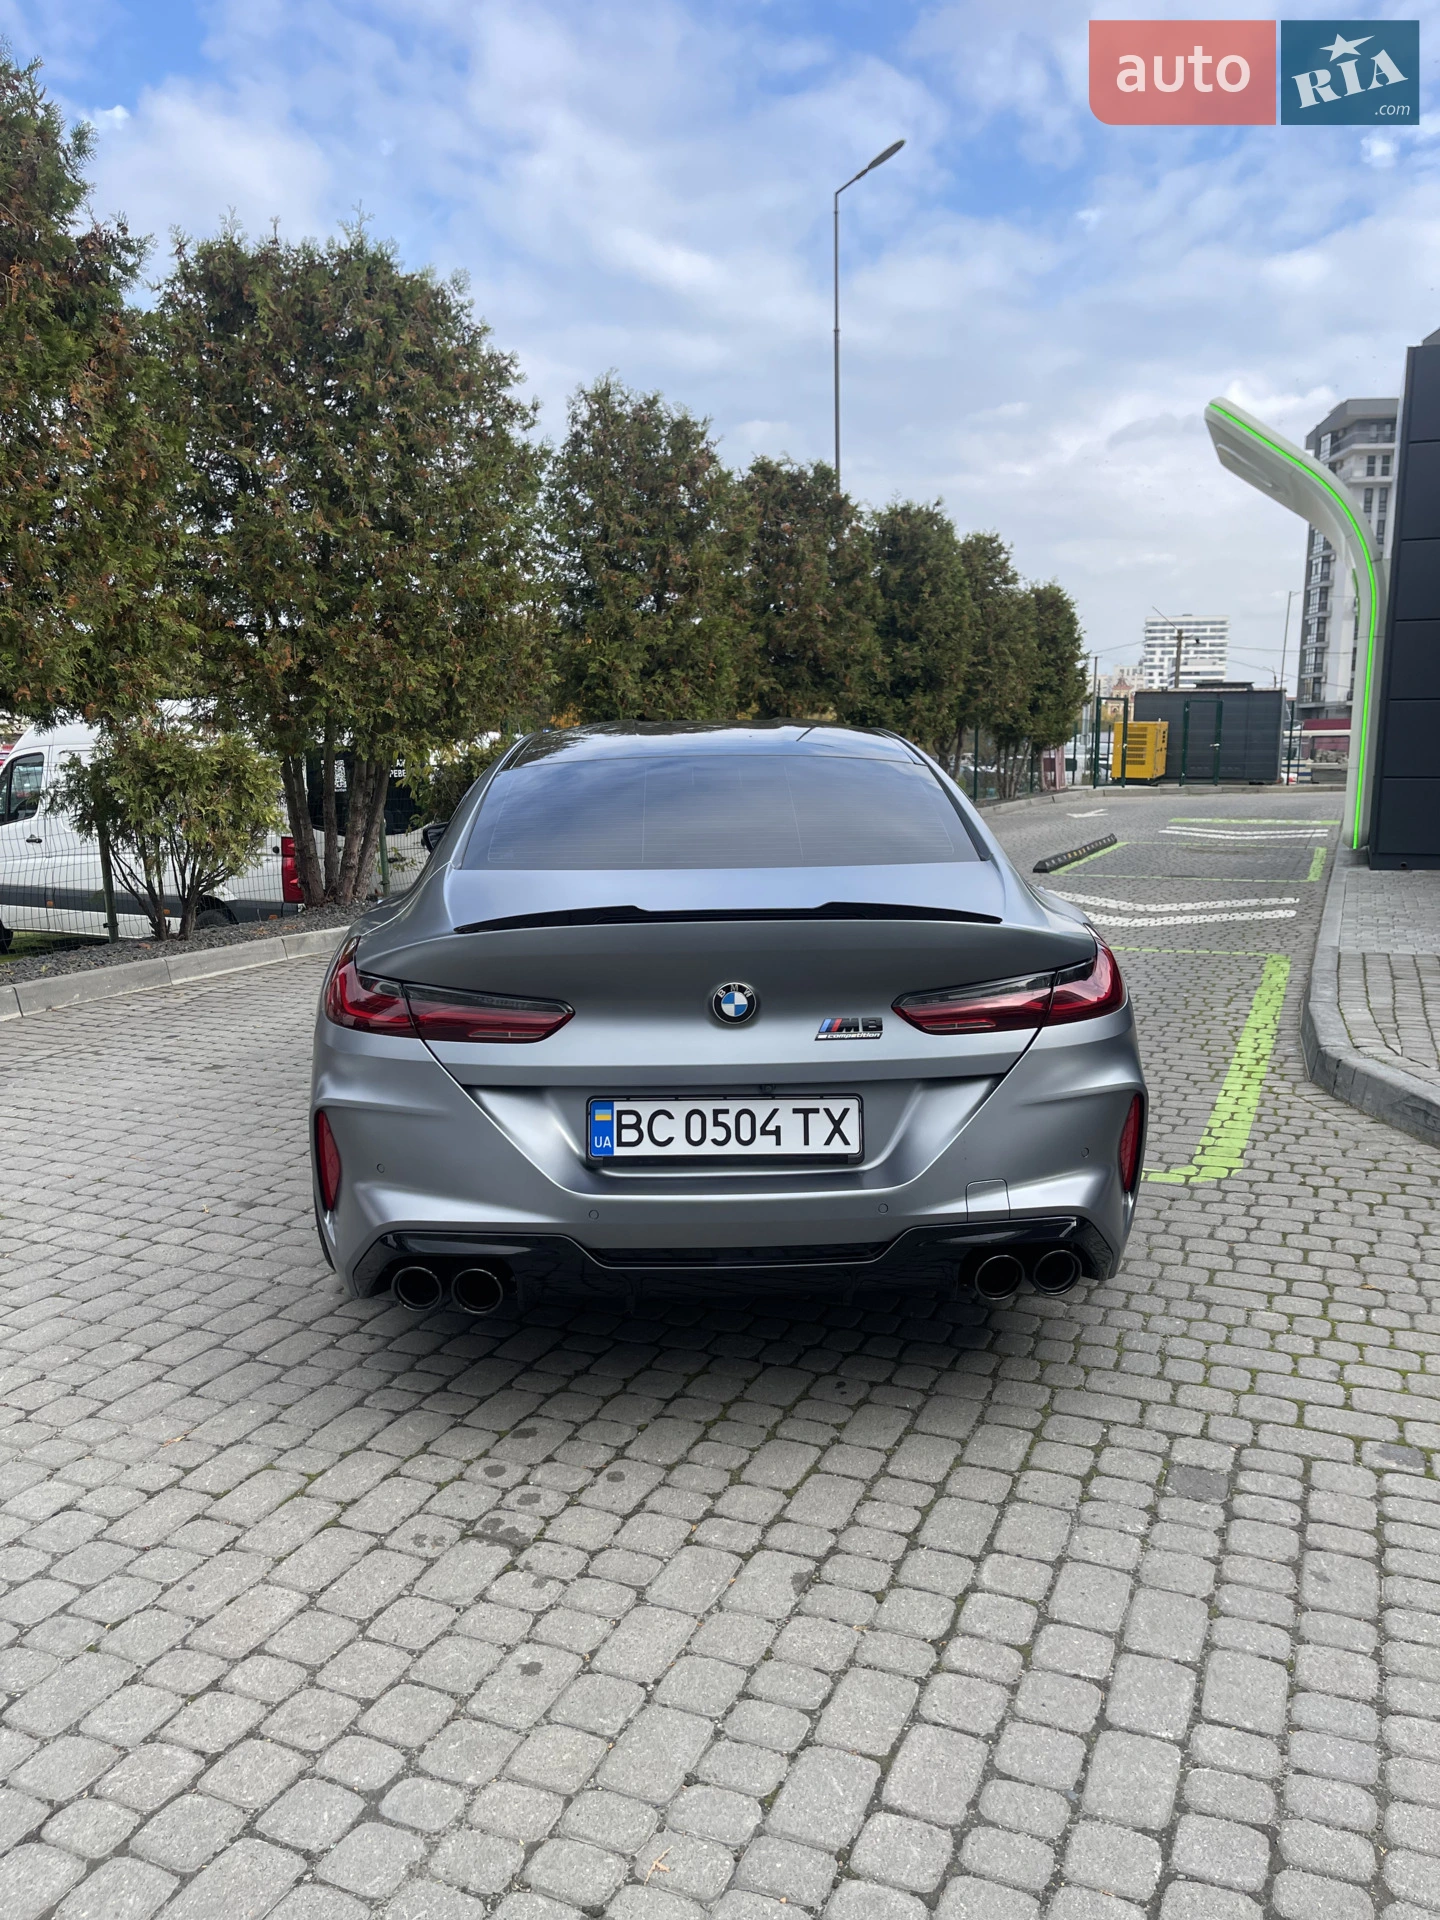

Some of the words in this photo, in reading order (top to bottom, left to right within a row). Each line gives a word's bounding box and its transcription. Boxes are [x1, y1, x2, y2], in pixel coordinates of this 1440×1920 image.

[717, 984, 753, 998] BMW
[616, 1108, 675, 1148] BC
[685, 1108, 782, 1147] 0504
[792, 1107, 851, 1146] TX
[594, 1136, 612, 1148] UA
